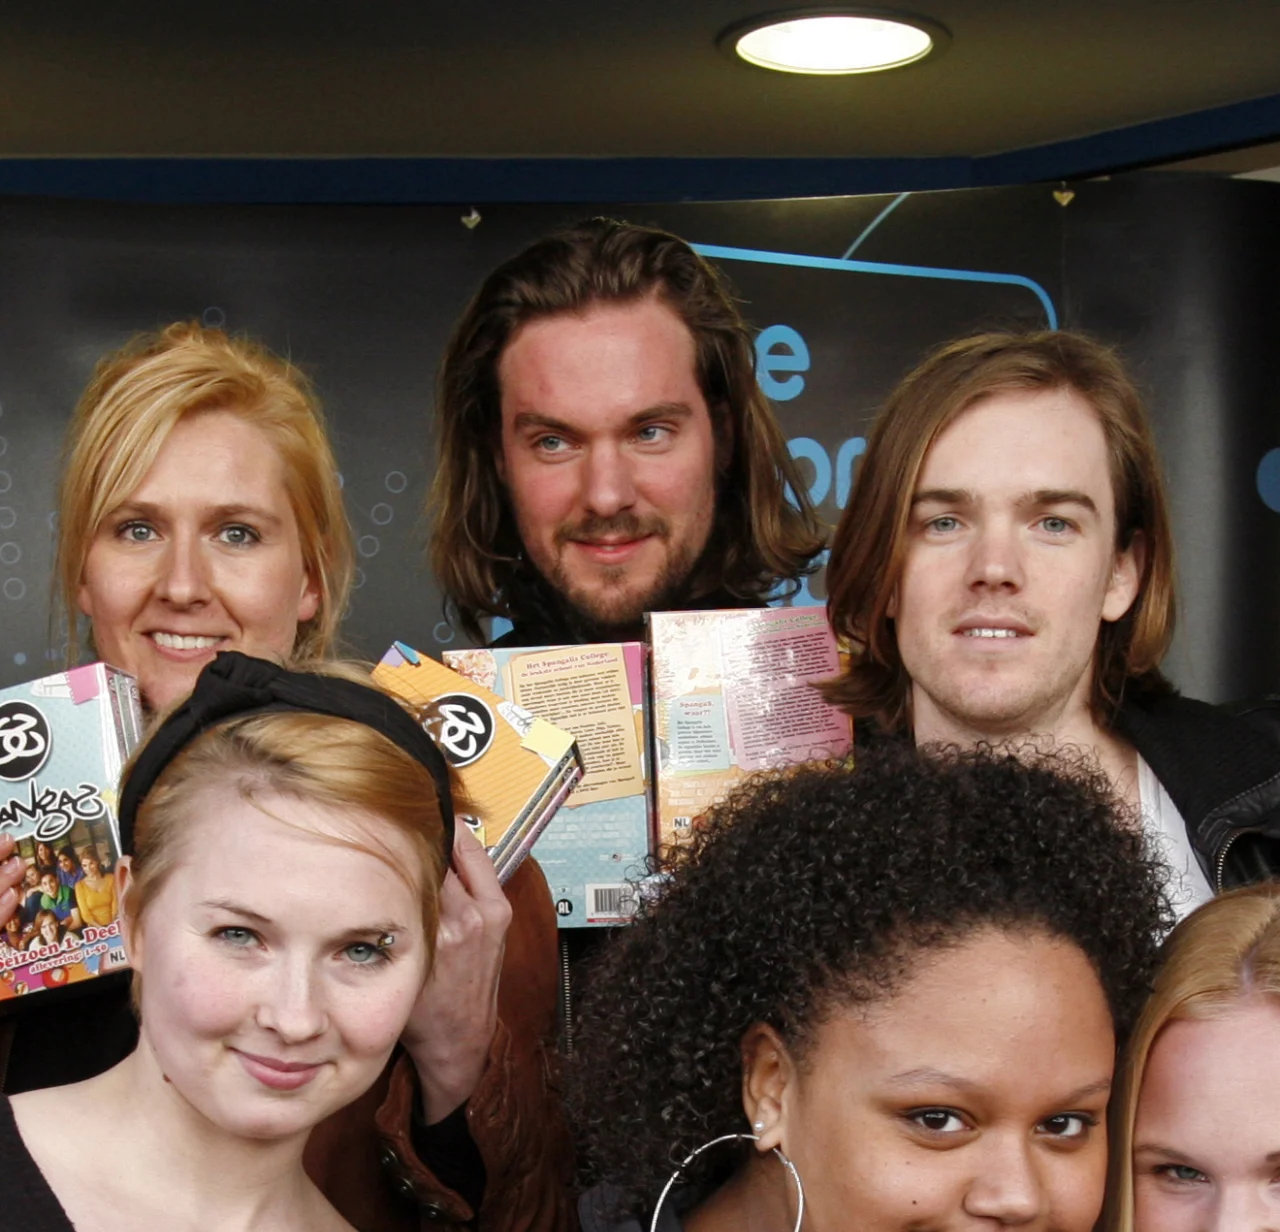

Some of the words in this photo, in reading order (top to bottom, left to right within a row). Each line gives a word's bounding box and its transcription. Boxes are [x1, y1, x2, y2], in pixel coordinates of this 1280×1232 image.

[674, 817, 690, 827] NL
[558, 901, 571, 914] AL
[30, 951, 82, 974] aflevering:
[110, 950, 125, 963] NL
